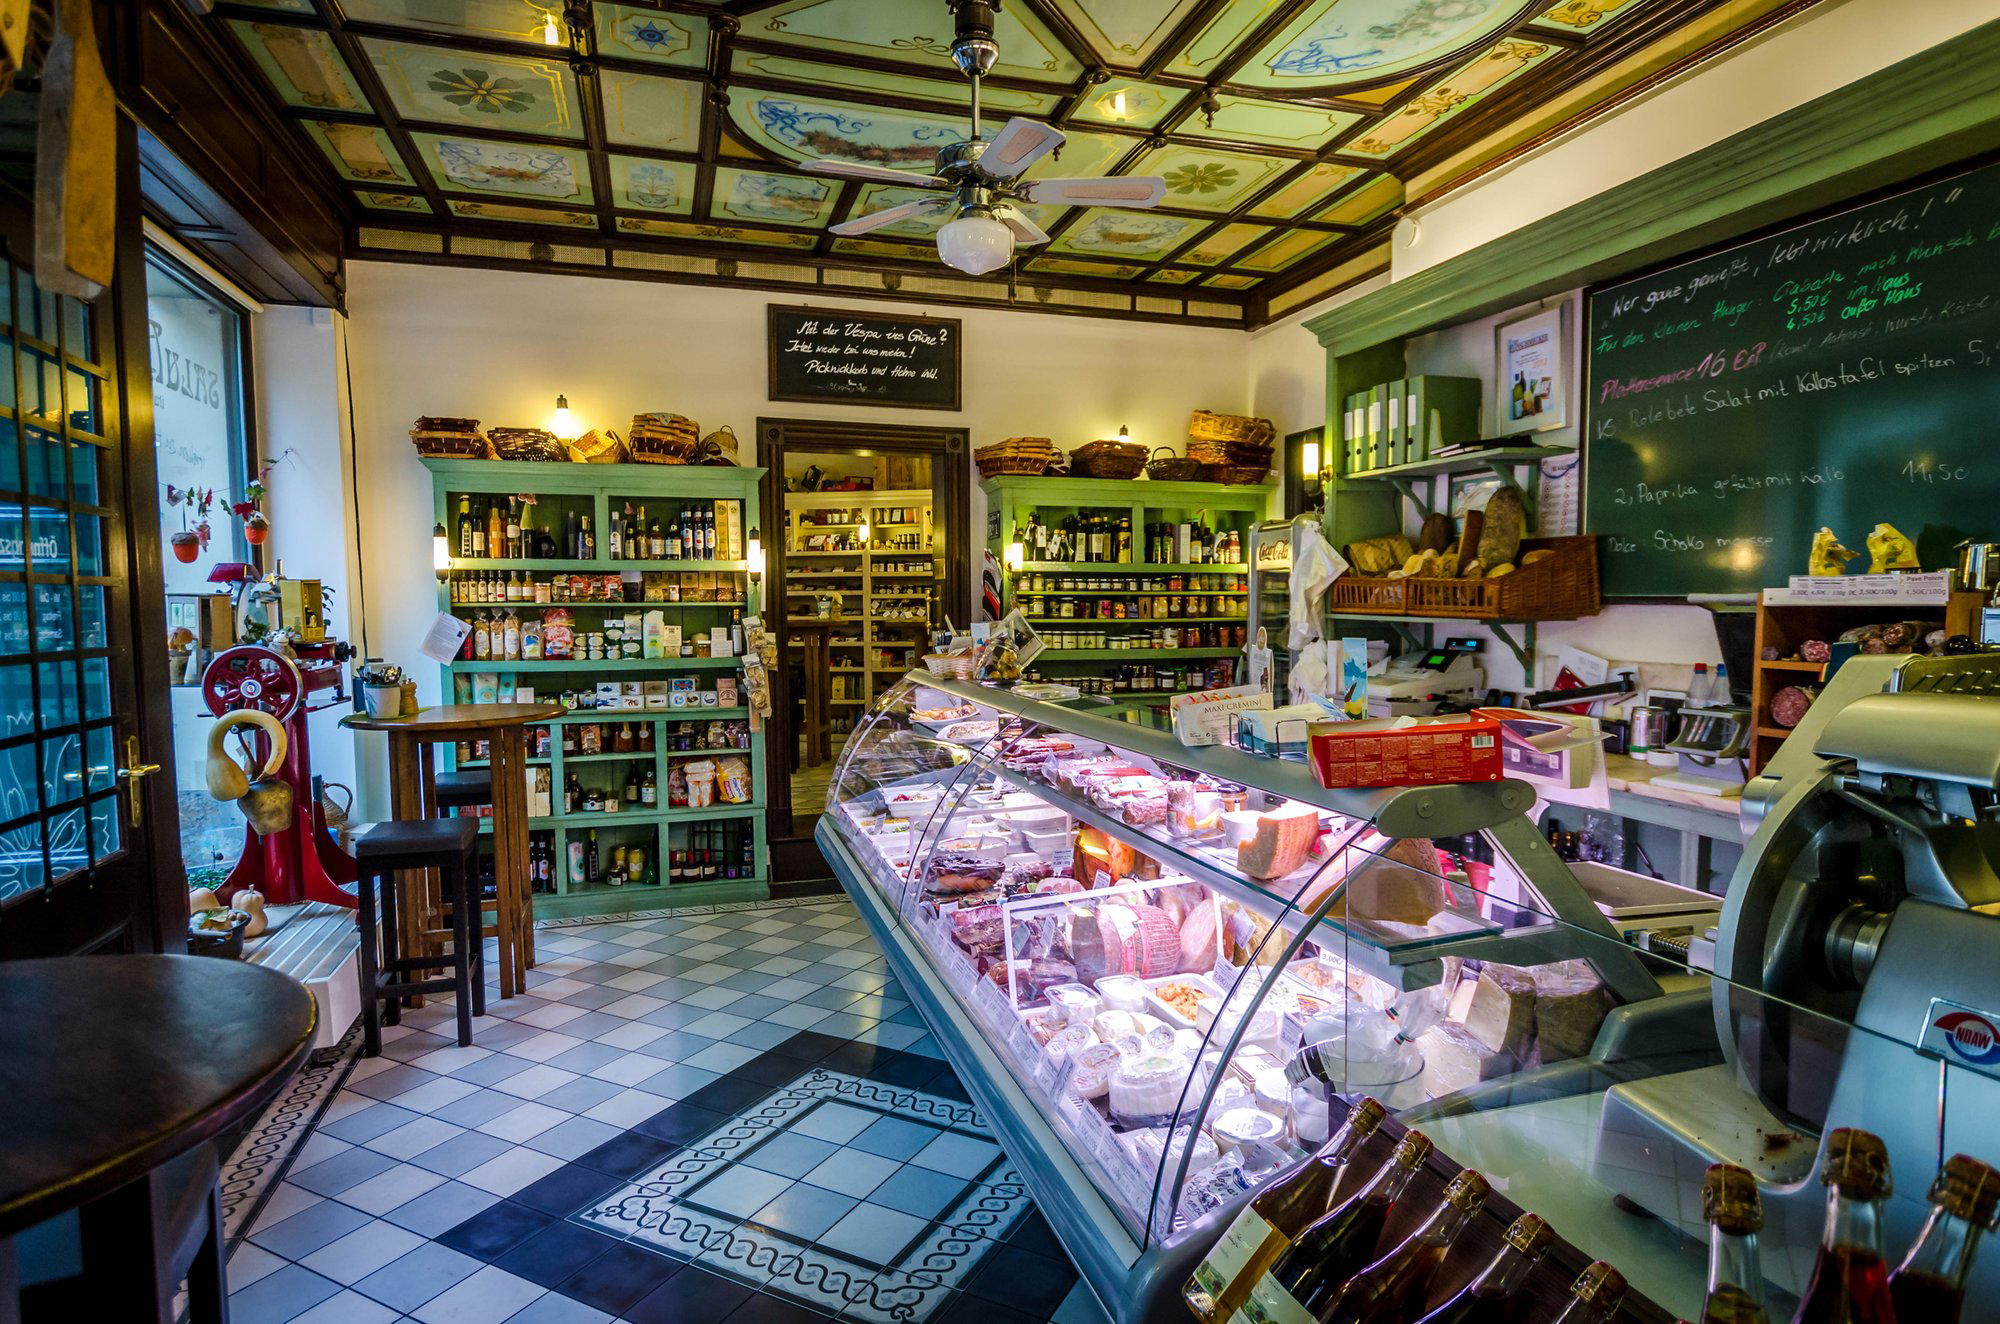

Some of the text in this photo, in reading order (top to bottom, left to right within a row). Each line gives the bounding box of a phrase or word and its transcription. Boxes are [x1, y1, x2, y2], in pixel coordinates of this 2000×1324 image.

[1876, 272, 1910, 292] Haus
[1884, 281, 1923, 306] Haus
[796, 320, 818, 335] Mit
[822, 324, 840, 336] der
[844, 323, 881, 340] Vespa
[885, 327, 904, 340] ins
[1622, 330, 1645, 348] den
[785, 340, 813, 353] Jetzt
[815, 344, 840, 354] wieder
[844, 344, 859, 355] bei
[862, 346, 879, 356] uns
[804, 359, 868, 375] Picknickkorb
[871, 366, 886, 377] und
[1704, 388, 1753, 412] Salat
[1758, 380, 1790, 400] mit
[1636, 482, 1699, 505] Paprika
[1765, 473, 1792, 488] mit
[1654, 529, 1705, 551] Schoko
[1204, 699, 1262, 714] MAXI CREMINI
[1955, 1026, 1992, 1050] NOAW
